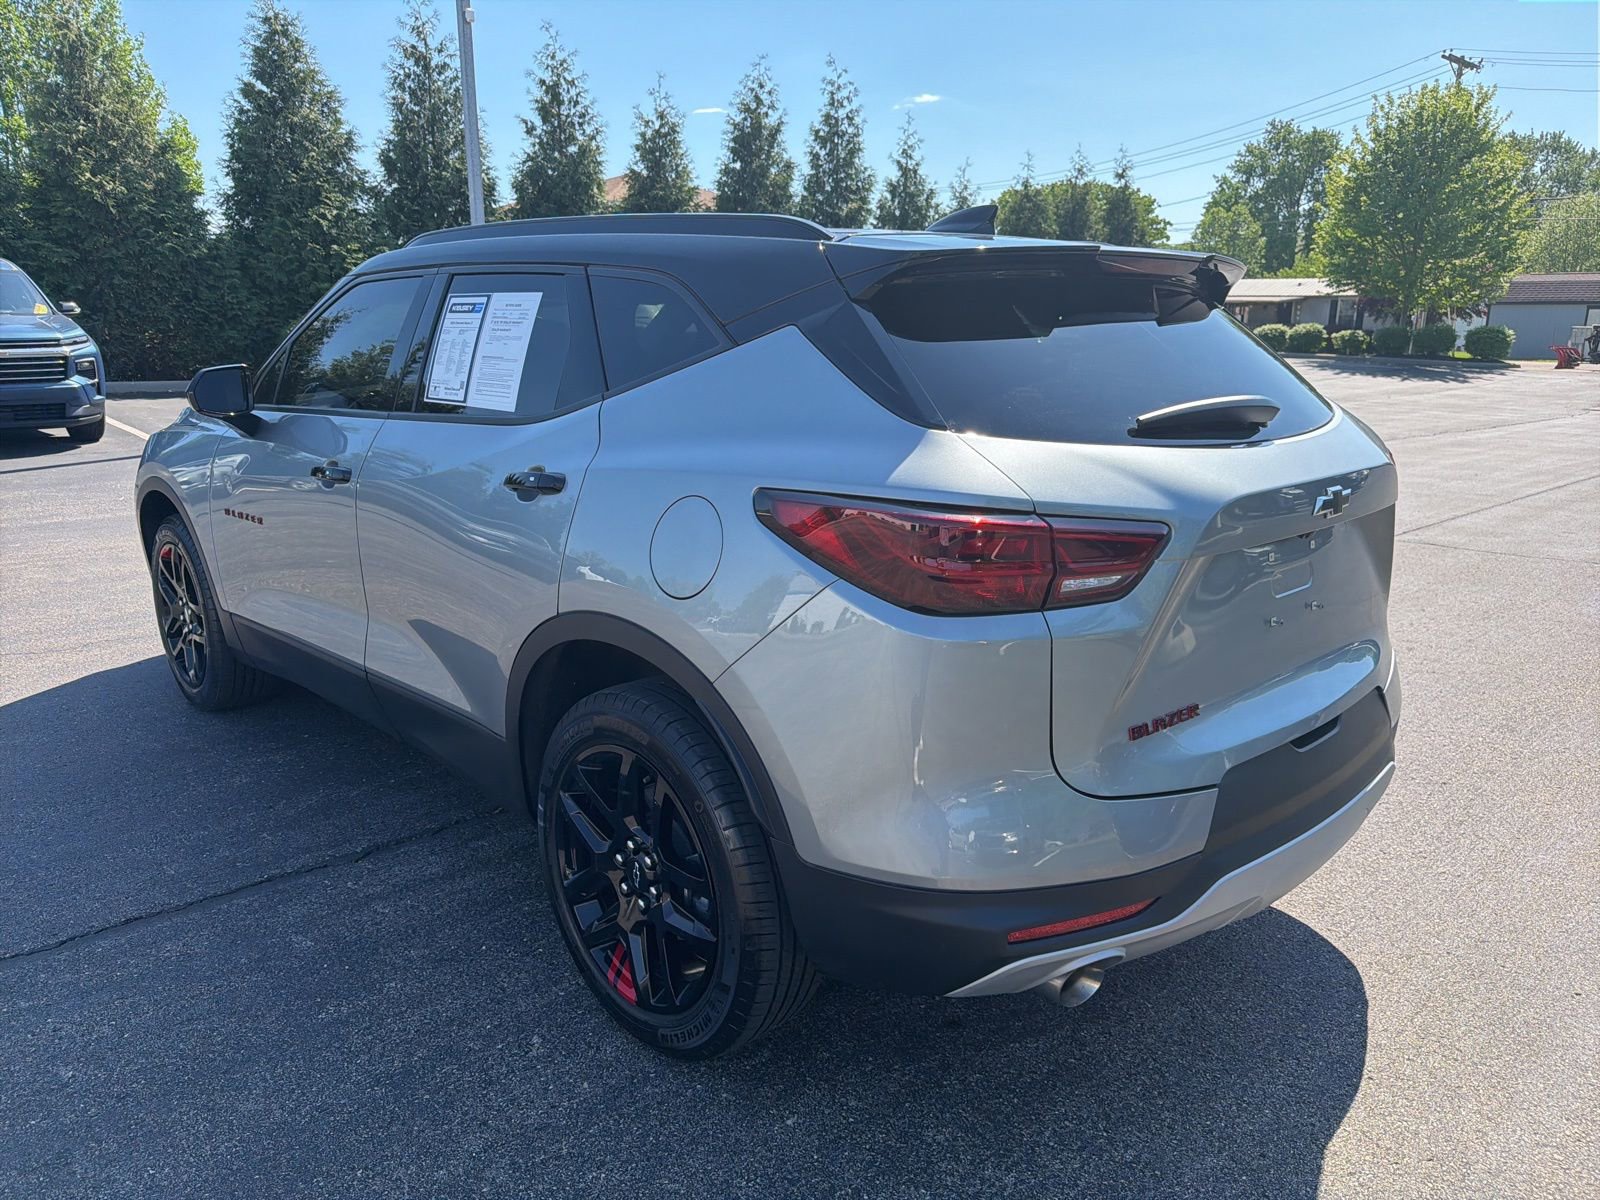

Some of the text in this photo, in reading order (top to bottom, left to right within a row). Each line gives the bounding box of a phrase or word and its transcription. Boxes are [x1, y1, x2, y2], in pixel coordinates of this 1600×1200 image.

[224, 508, 264, 526] BLAZER
[1127, 702, 1200, 742] BLAZER
[660, 1010, 713, 1045] MICHELIN
